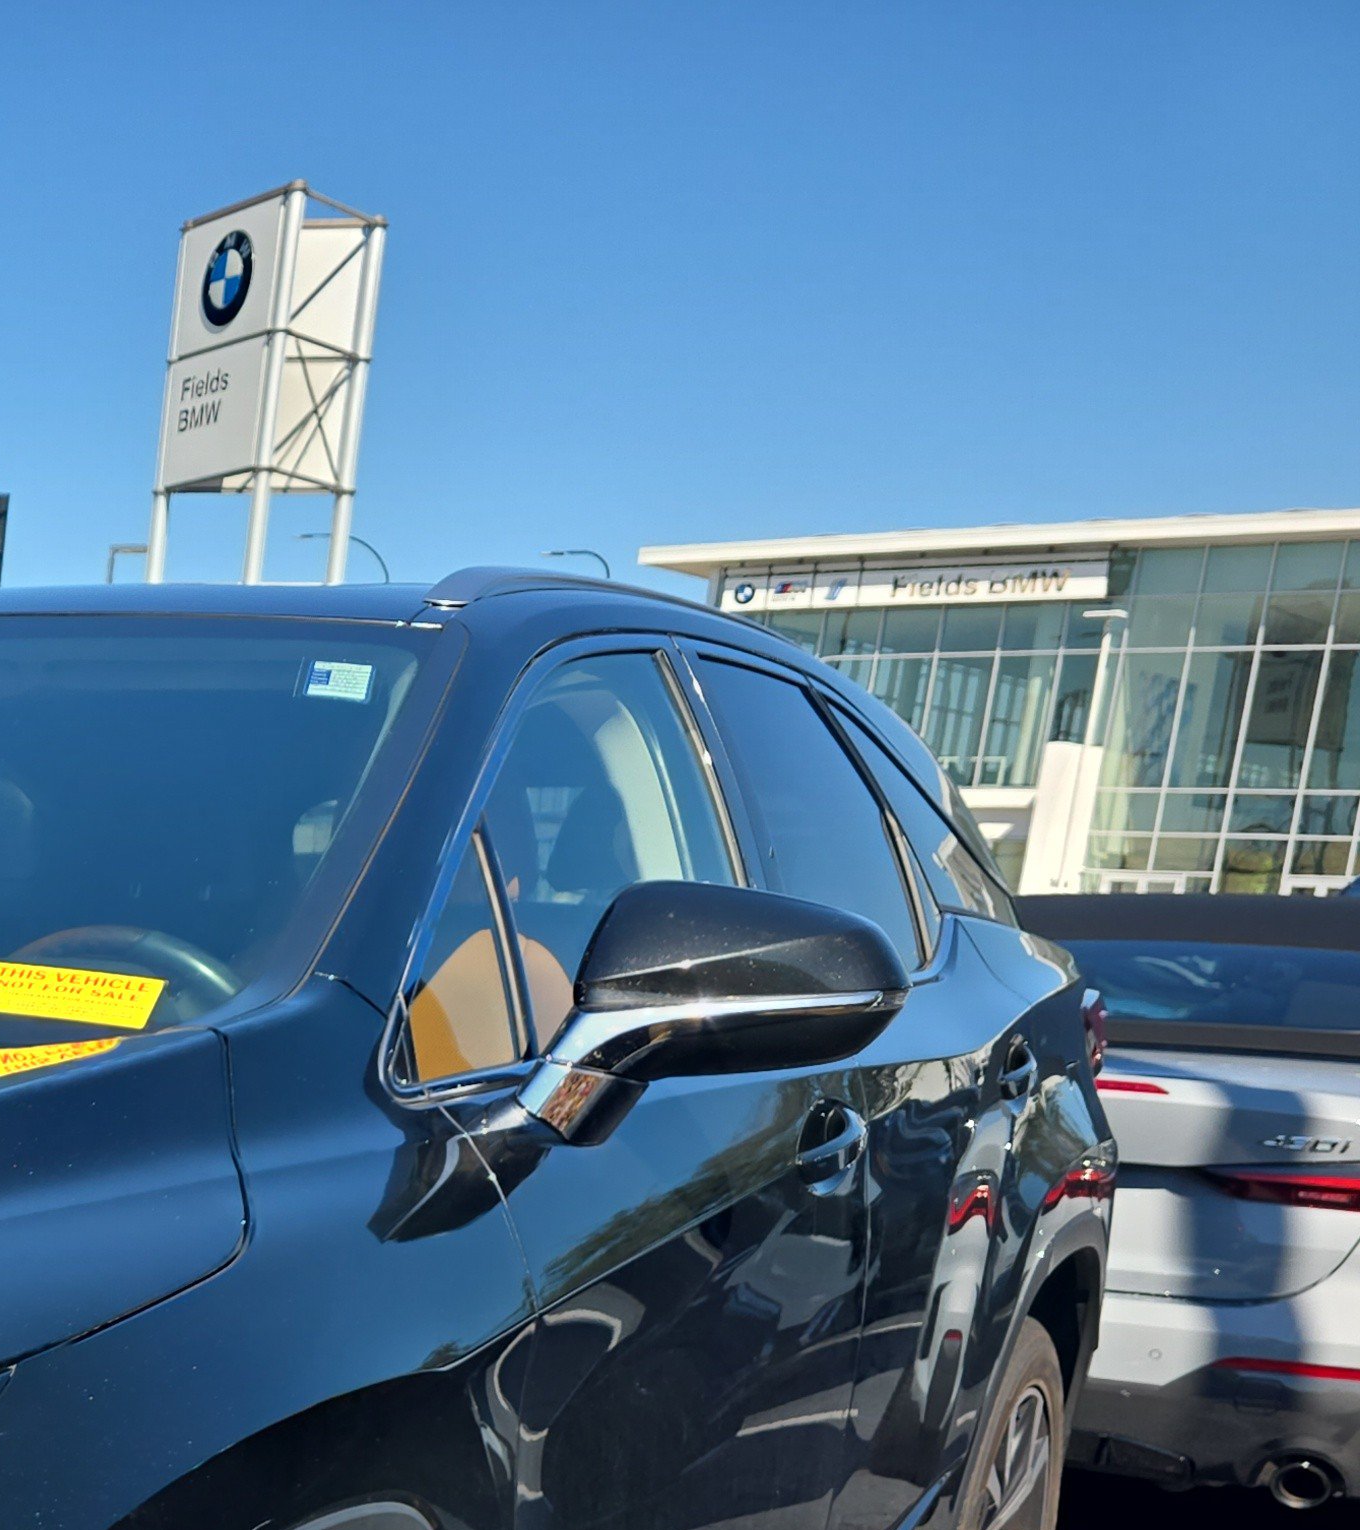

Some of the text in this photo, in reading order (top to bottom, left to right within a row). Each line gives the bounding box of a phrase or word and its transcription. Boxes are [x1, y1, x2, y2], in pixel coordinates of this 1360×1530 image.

[180, 368, 230, 401] Fields
[177, 399, 222, 432] BMW
[890, 568, 1072, 597] Fields BMW
[0, 966, 151, 993] THIS VEHICLE
[42, 983, 83, 995] FOR
[90, 989, 140, 1003] SALE
